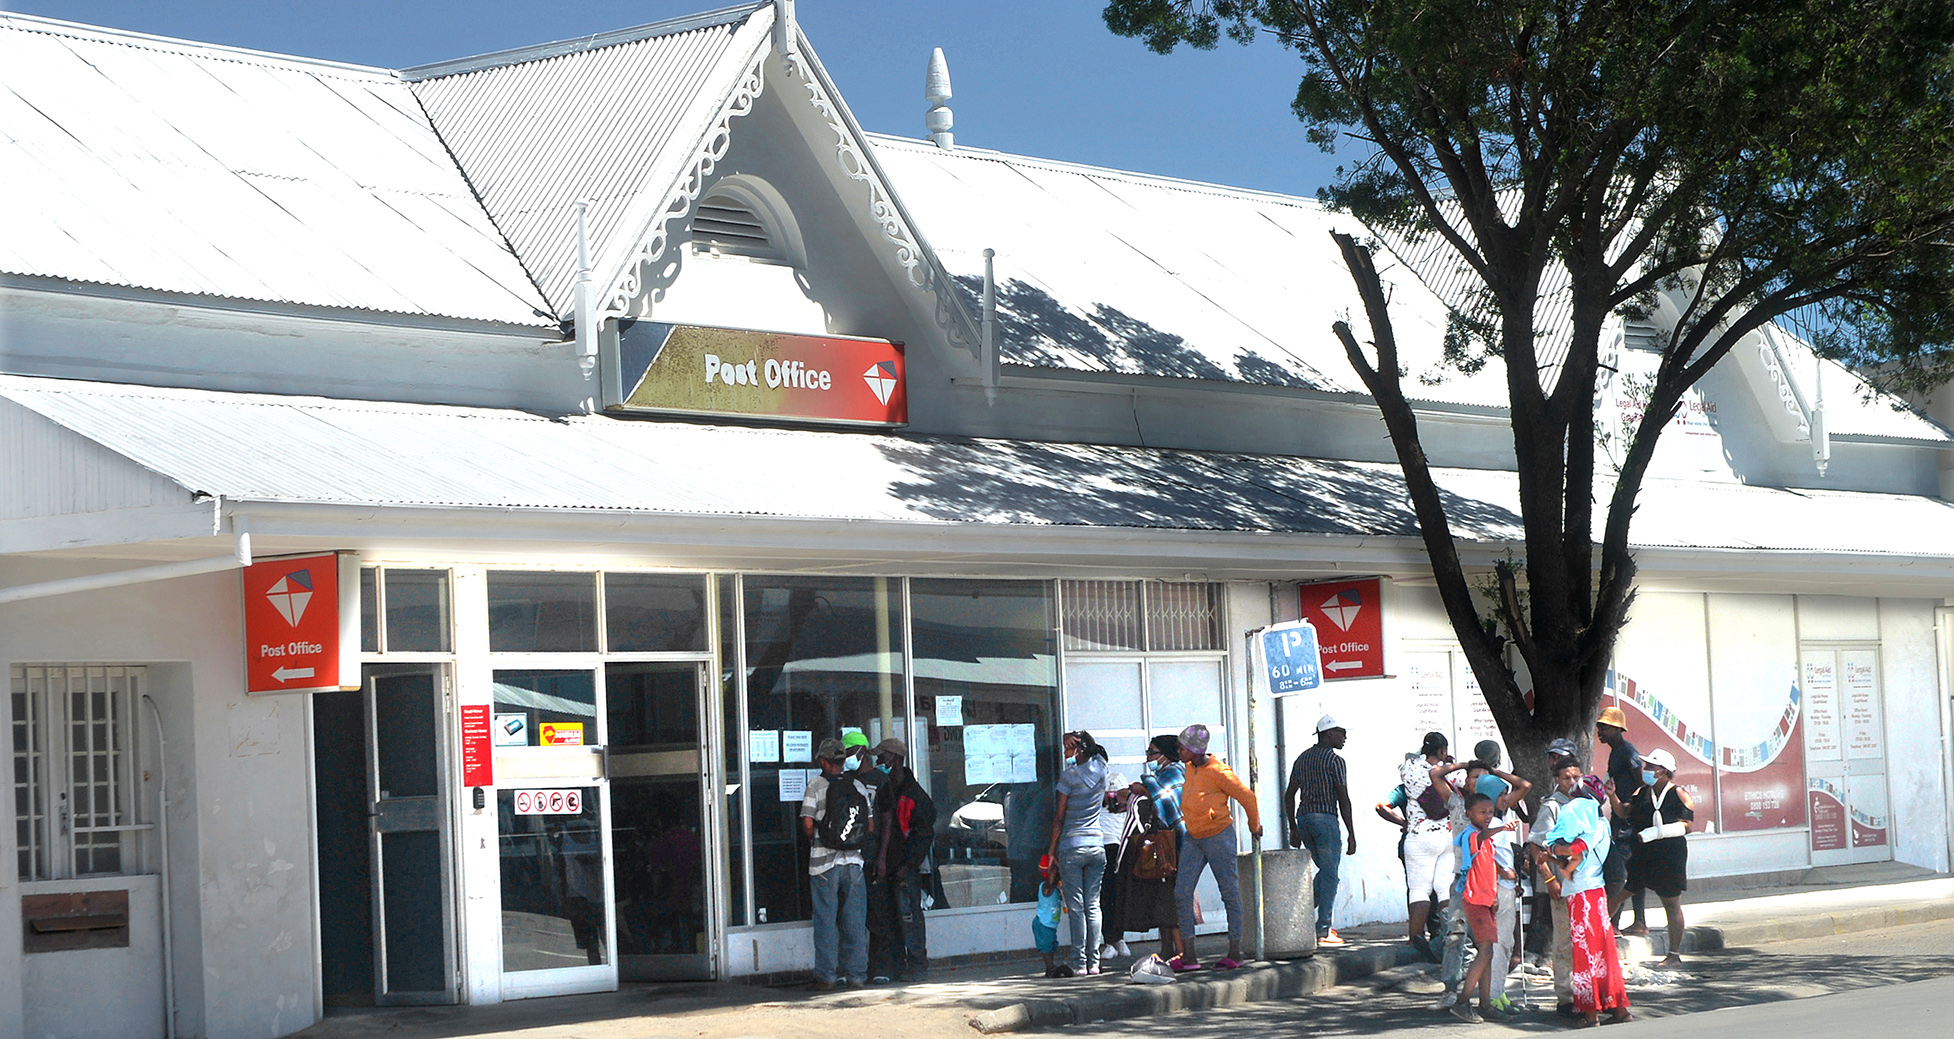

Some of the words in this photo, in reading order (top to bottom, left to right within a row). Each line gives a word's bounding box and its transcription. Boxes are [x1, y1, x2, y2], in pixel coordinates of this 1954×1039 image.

[705, 354, 758, 387] Post
[764, 358, 832, 391] Office
[1689, 399, 1705, 414] Legal
[1706, 401, 1717, 413] Aid
[261, 644, 286, 657] Post
[288, 641, 322, 655] Office
[1281, 631, 1302, 657] P
[1318, 644, 1338, 654] Post
[1340, 641, 1369, 652] Office
[1272, 664, 1290, 678] 60
[1296, 664, 1315, 675] MIN
